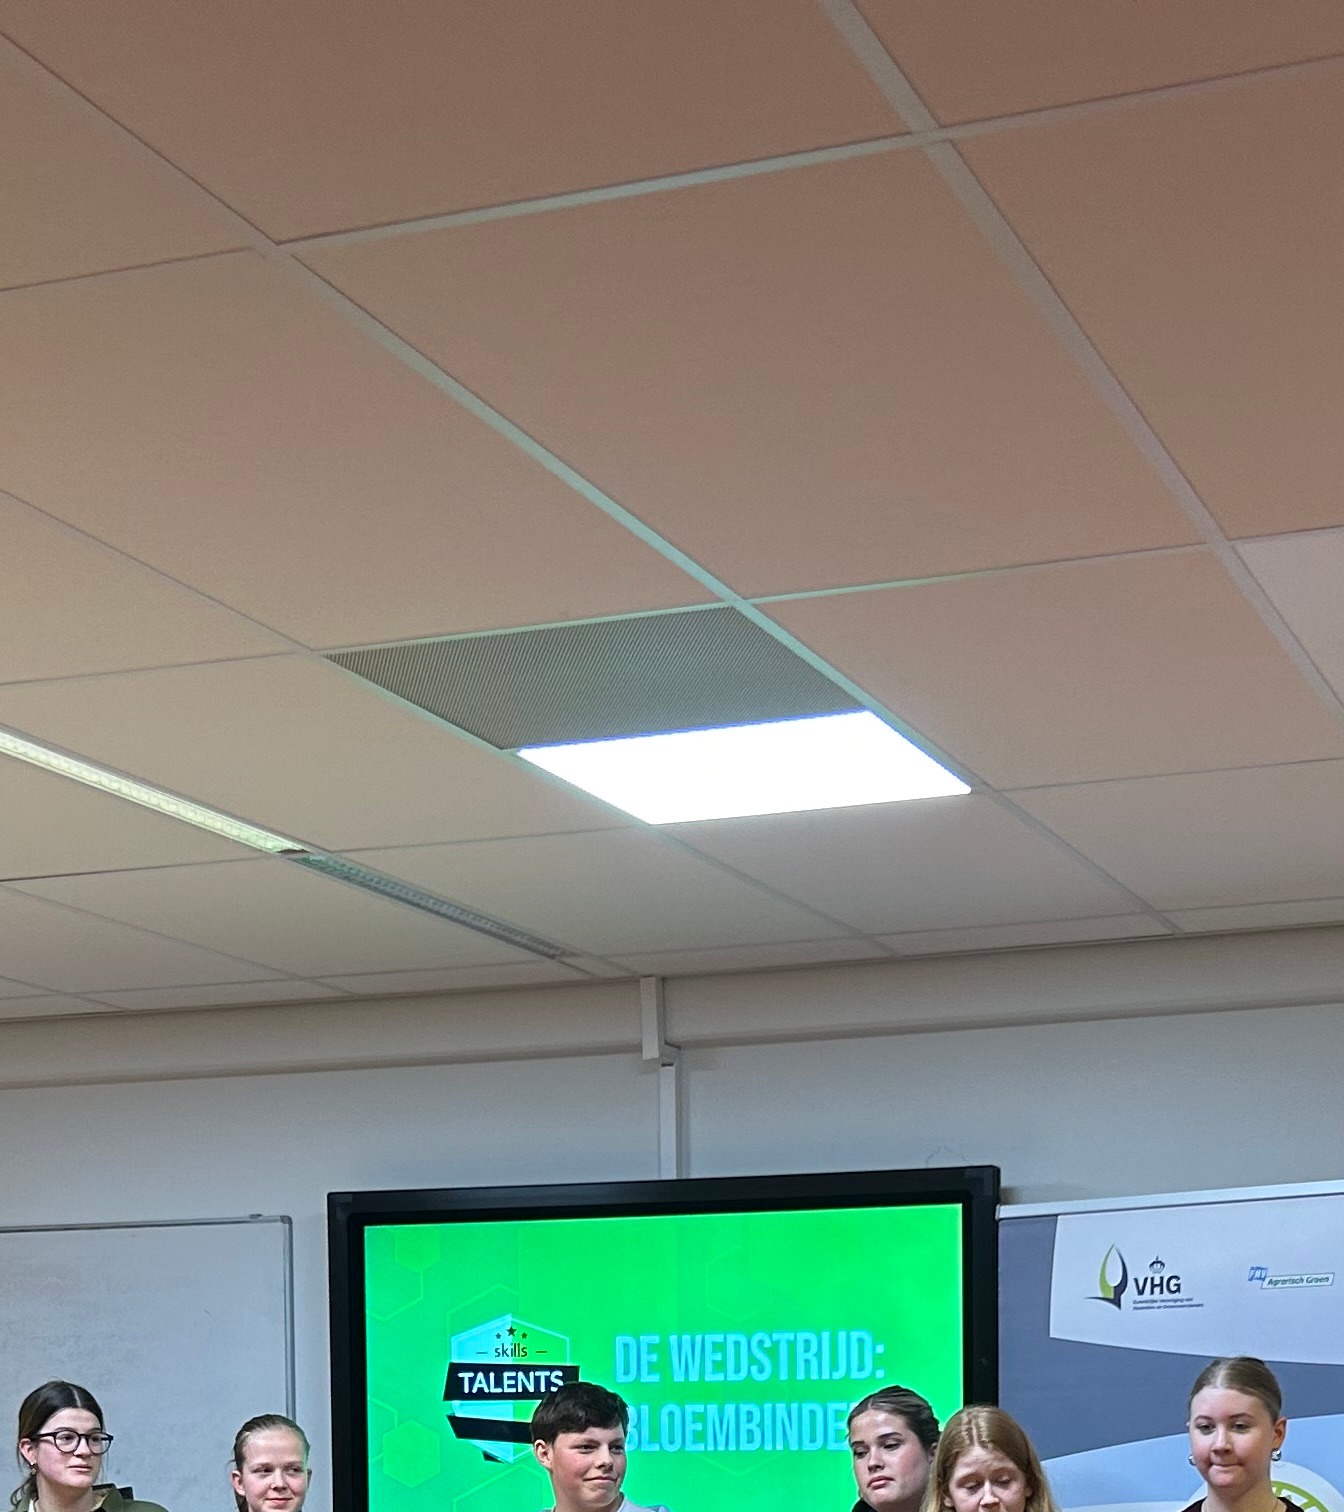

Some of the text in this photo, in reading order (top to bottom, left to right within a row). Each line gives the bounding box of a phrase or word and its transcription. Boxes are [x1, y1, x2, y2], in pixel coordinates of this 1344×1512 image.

[1132, 1275, 1181, 1296] VHG
[494, 1342, 528, 1358] skills
[614, 1331, 885, 1383] DE WEDSTRIJD:
[457, 1370, 564, 1393] TALENTS
[626, 1401, 856, 1451] BLOEMBINDE
